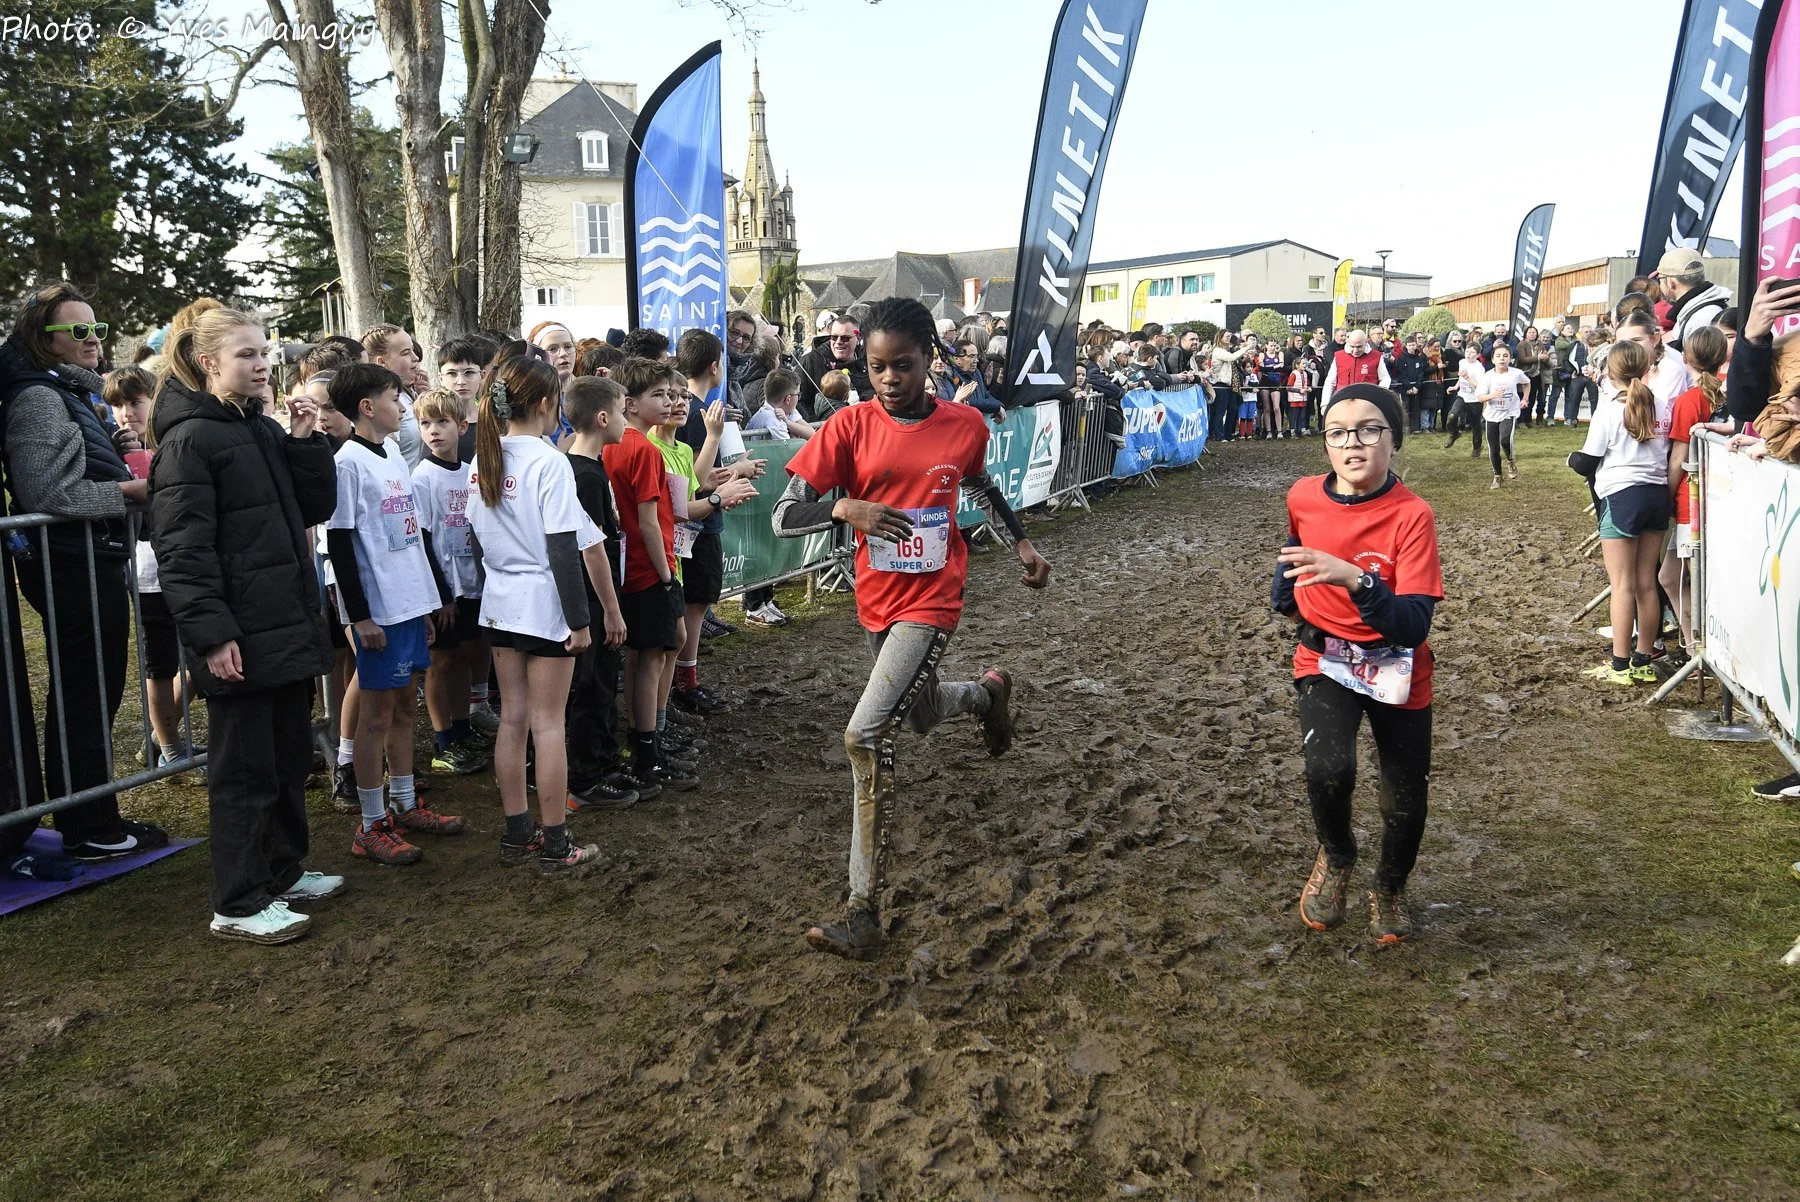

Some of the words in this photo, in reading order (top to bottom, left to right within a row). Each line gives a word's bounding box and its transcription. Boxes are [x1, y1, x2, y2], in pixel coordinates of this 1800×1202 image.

[1664, 0, 1763, 252] KINET
[1038, 2, 1126, 309] KINETIK
[642, 299, 721, 323] SAINT
[986, 430, 1014, 466] DIT
[505, 479, 514, 488] U
[921, 511, 948, 523] KINDER
[896, 536, 924, 558] 169
[722, 551, 745, 573] han
[889, 560, 922, 570] SUPER
